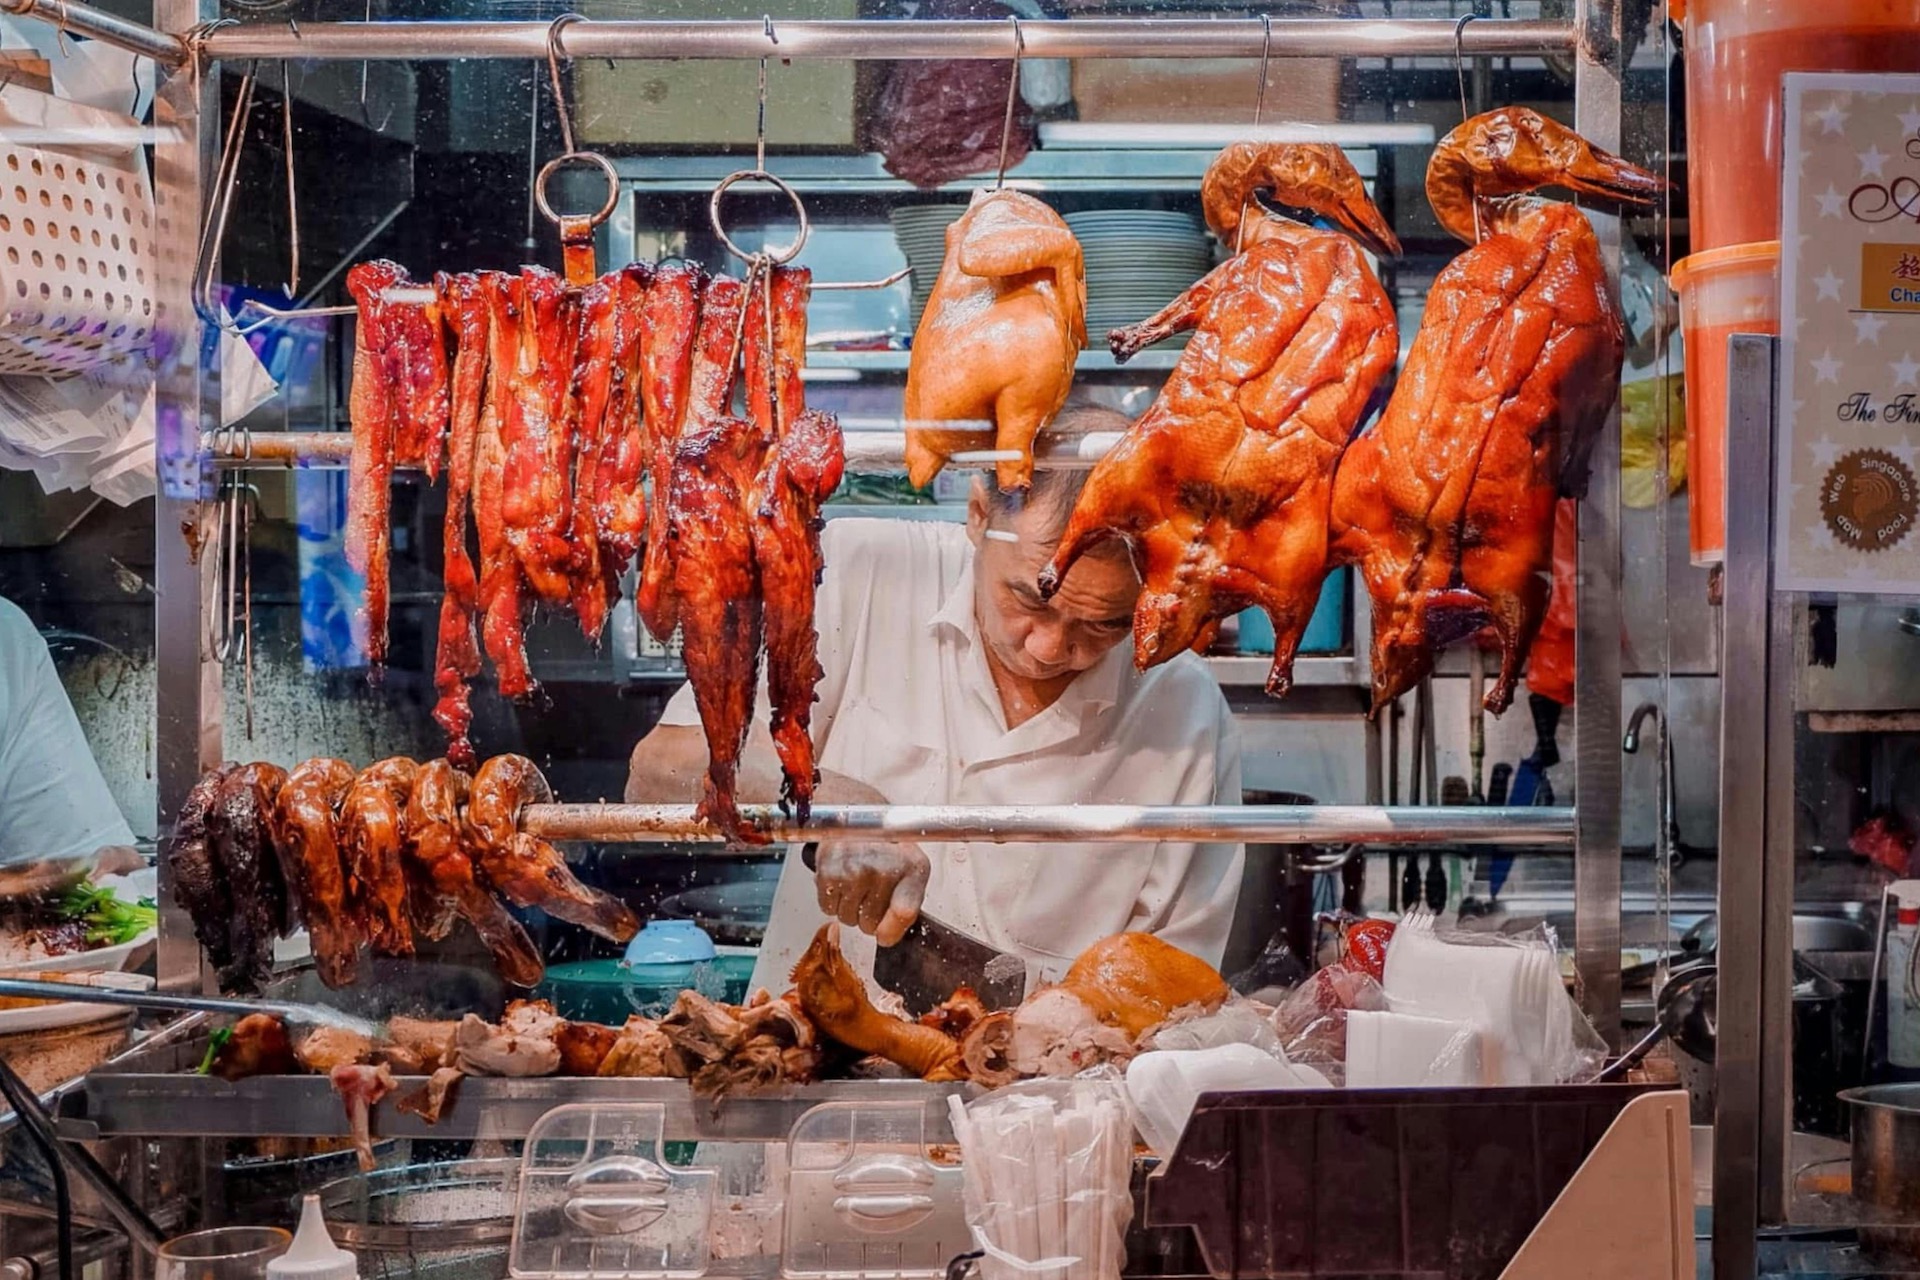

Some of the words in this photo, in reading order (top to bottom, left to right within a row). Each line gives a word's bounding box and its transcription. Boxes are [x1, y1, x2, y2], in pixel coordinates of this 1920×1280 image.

[1837, 392, 1876, 422] The
[1883, 394, 1920, 423] Fin
[1829, 473, 1847, 503] Web
[1860, 457, 1911, 502] Singapore
[1836, 514, 1863, 540] Map
[1877, 513, 1908, 541] Food
